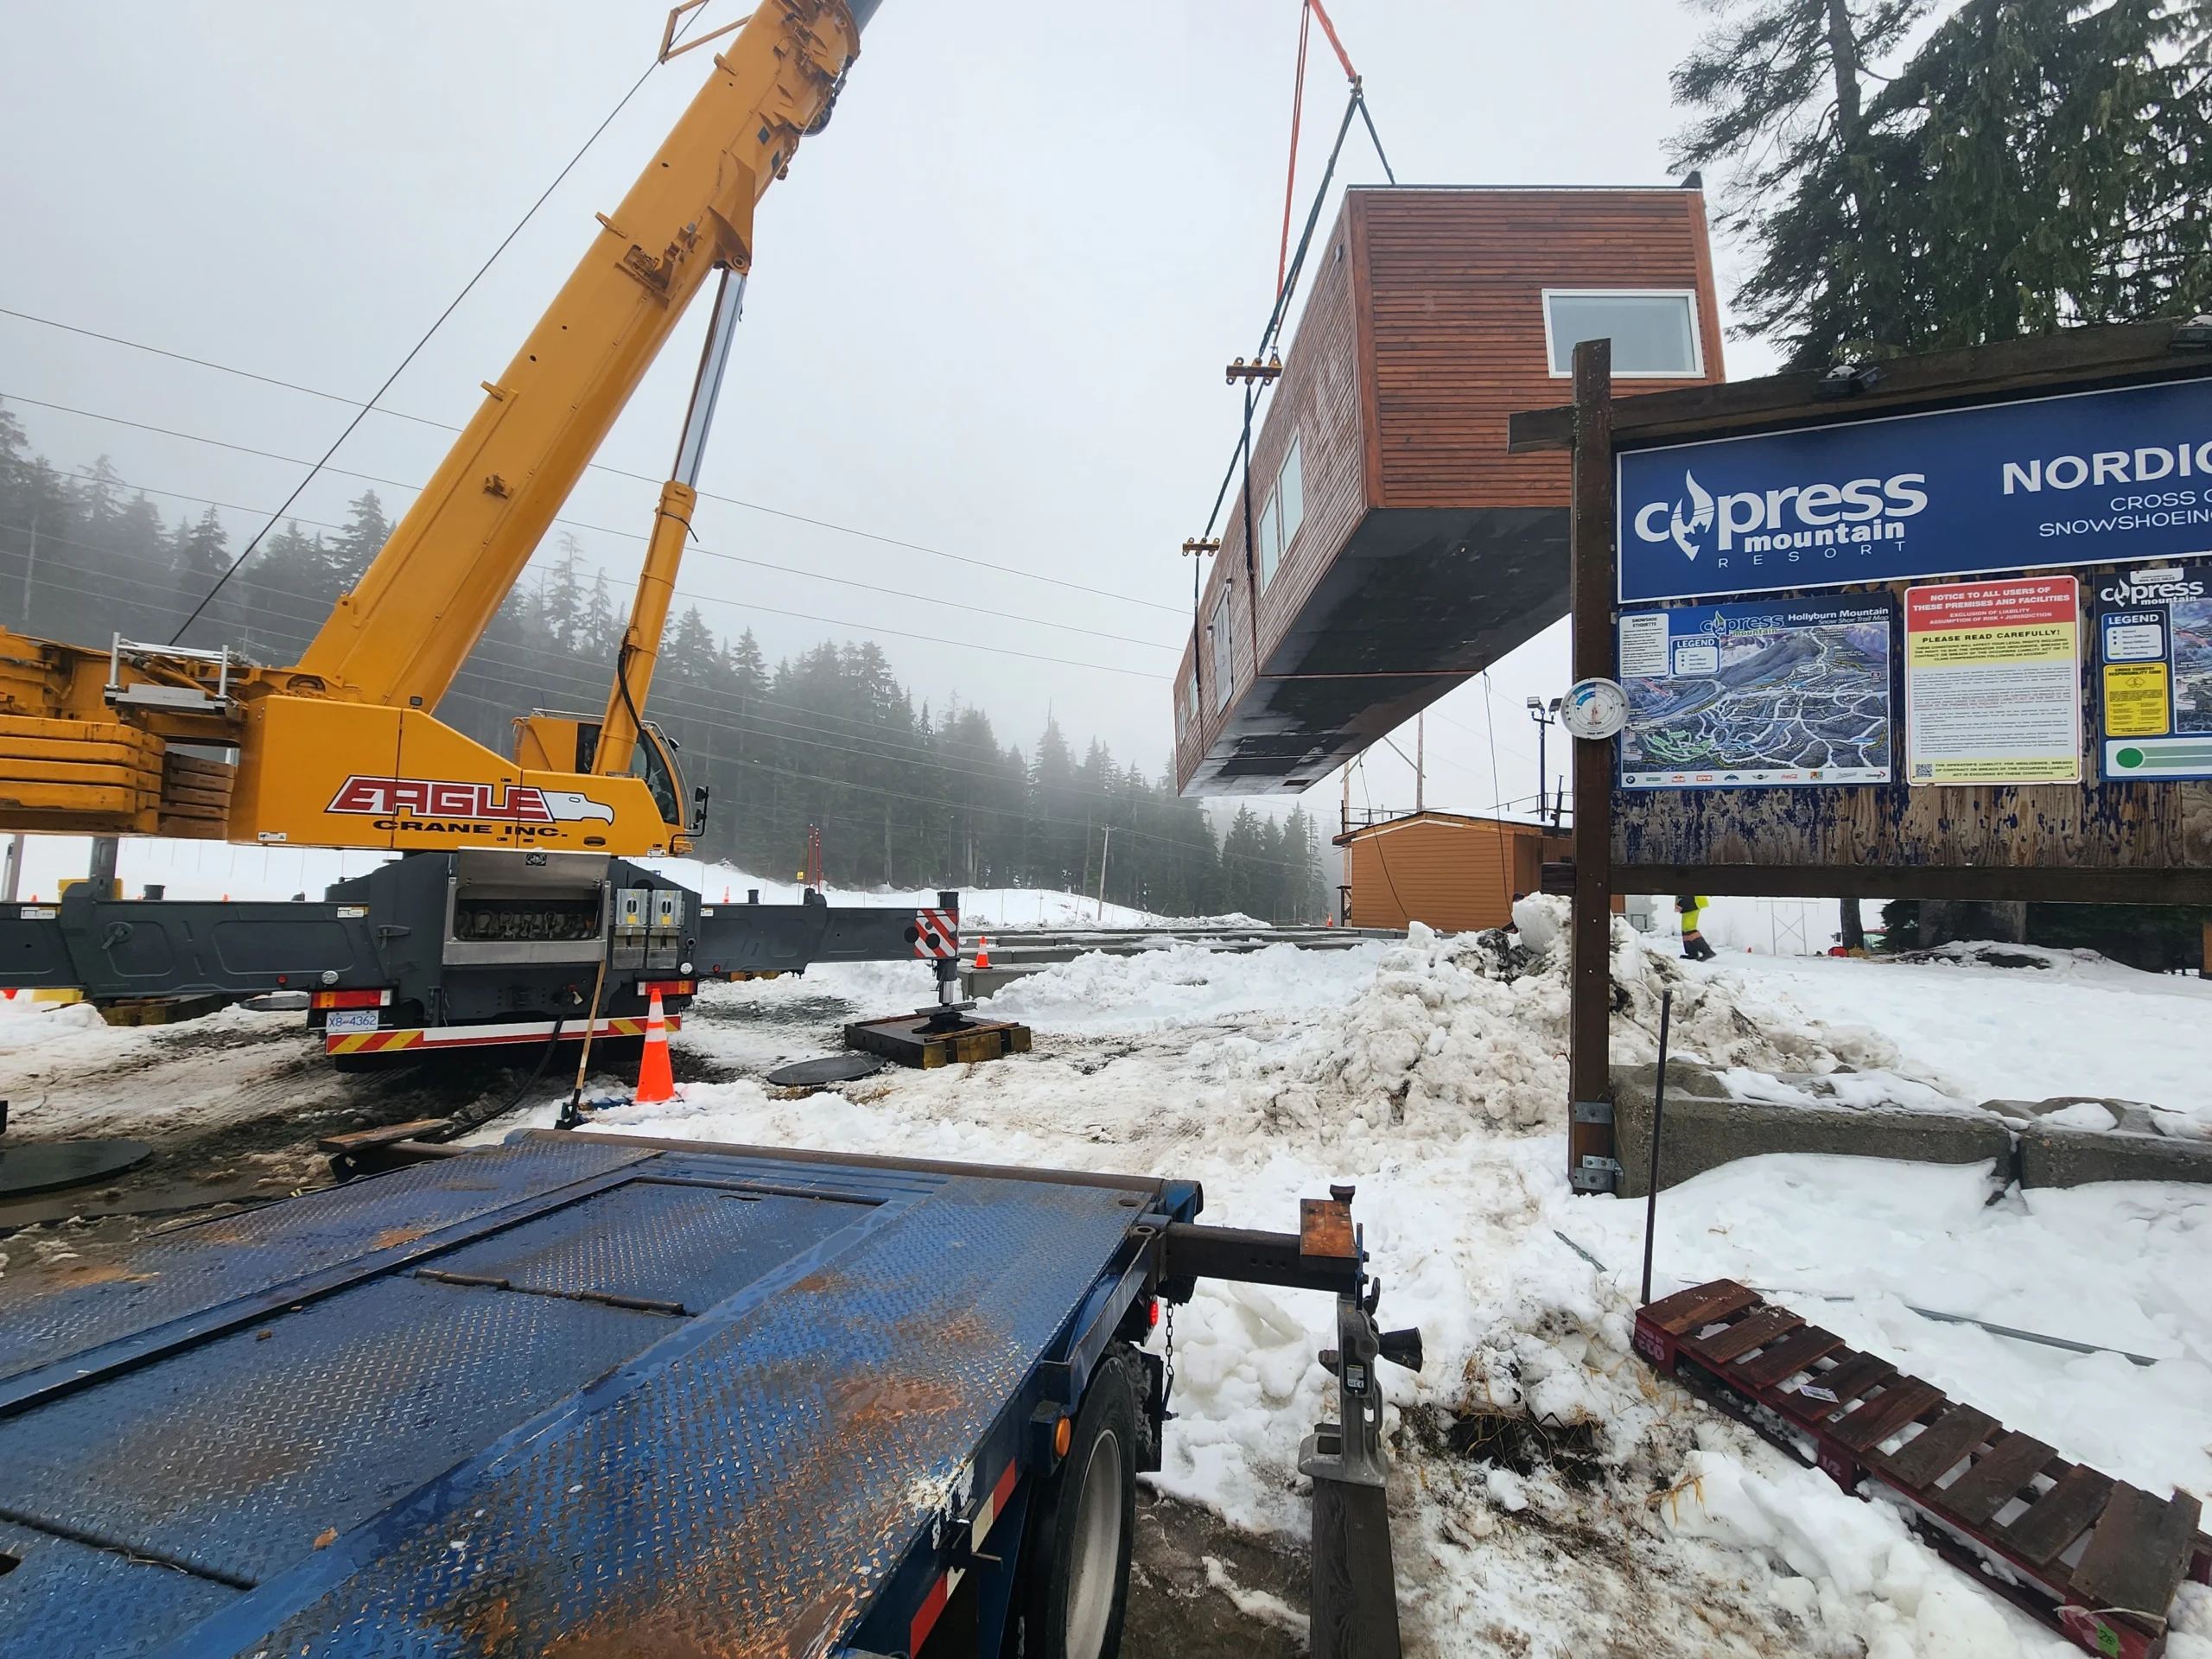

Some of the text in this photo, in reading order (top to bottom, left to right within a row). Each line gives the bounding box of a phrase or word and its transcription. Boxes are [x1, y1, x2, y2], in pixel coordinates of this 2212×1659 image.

[2111, 491, 2196, 511] CROSS
[1635, 469, 1928, 561] cypress
[2039, 508, 2212, 537] SNOWSHOEIN
[1745, 519, 1905, 552] mountain
[1719, 541, 1906, 568] RESORT
[1930, 593, 1964, 601] NOTICE
[2101, 578, 2204, 607] cypress
[2141, 595, 2196, 605] mountain
[1945, 600, 1993, 609] PREMISES
[2018, 594, 2070, 604] FACILITIES
[1789, 607, 1889, 621] Hollyburn Mountain
[2108, 614, 2159, 625] LEGEND
[1700, 610, 1784, 639] cypress
[1732, 628, 1777, 637] mountain
[1997, 630, 2061, 639] CAREFULLY!
[1677, 639, 1715, 648] LEGEND
[325, 776, 555, 823] EAGLE
[372, 820, 568, 837] CRANE INC.
